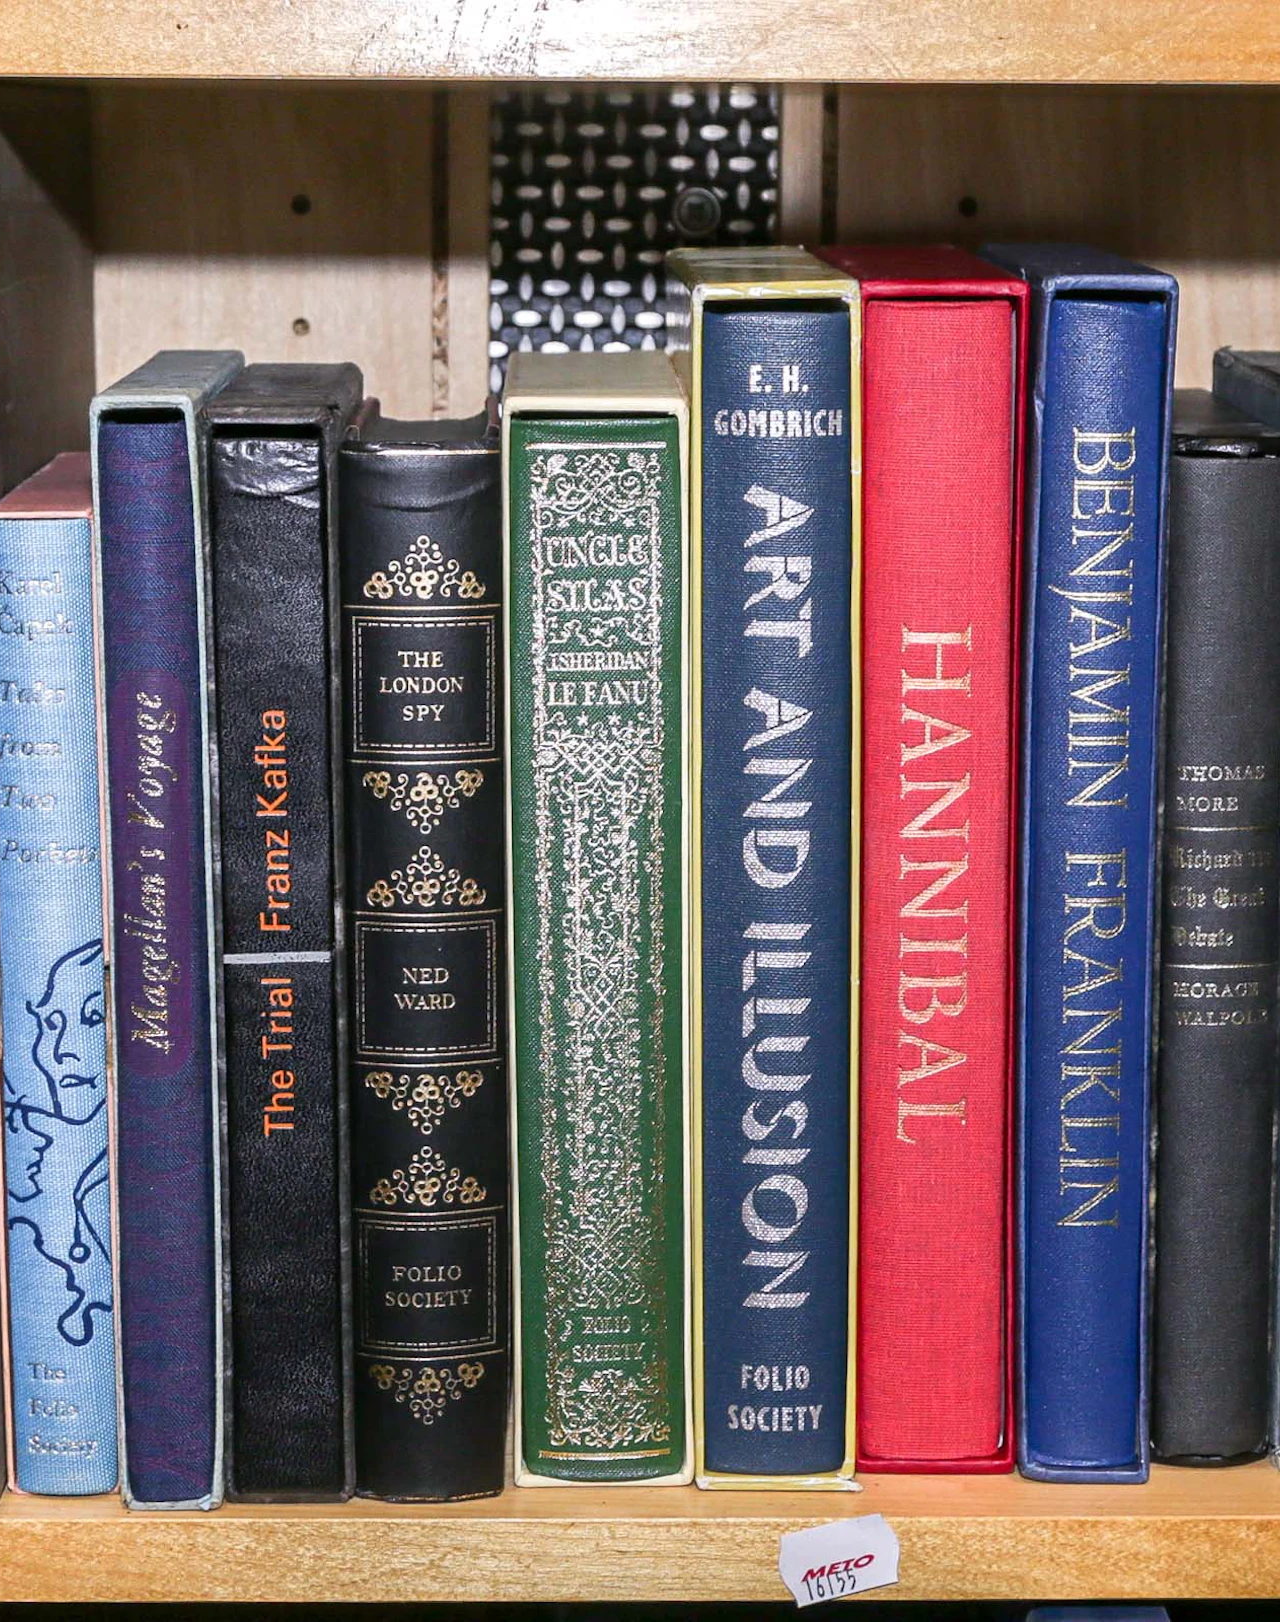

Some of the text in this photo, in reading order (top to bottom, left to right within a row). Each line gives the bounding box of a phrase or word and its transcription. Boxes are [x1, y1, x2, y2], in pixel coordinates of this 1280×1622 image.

[750, 366, 808, 393] E. H.
[714, 410, 843, 438] GOMBRICH
[543, 531, 648, 567] UNCLE
[545, 578, 649, 612] SILAS
[398, 650, 443, 668] THE
[379, 676, 463, 694] LONDON
[547, 681, 649, 706] LE FANU
[402, 704, 445, 722] SPY
[1177, 765, 1265, 782] THOMAS
[1177, 797, 1239, 812] MORE
[255, 708, 291, 931] Franz Kafka
[1047, 426, 1136, 1228] BENJAMIN FRANKLIN
[124, 691, 181, 1054] Magellan's Voyage
[898, 623, 973, 1145] HANNIBAL
[741, 484, 816, 1309] ART AND ILLUSION
[403, 967, 450, 984] NED
[394, 993, 456, 1011] WARD
[1173, 982, 1259, 998] HORACE
[261, 977, 295, 1136] The Trial
[392, 1265, 461, 1282] FOLIO
[385, 1288, 472, 1309] SOCIETY
[741, 1365, 810, 1392] FOLIO
[727, 1404, 823, 1431] SOCIETY
[801, 1554, 875, 1583] METO
[806, 1568, 856, 1601] 16155
